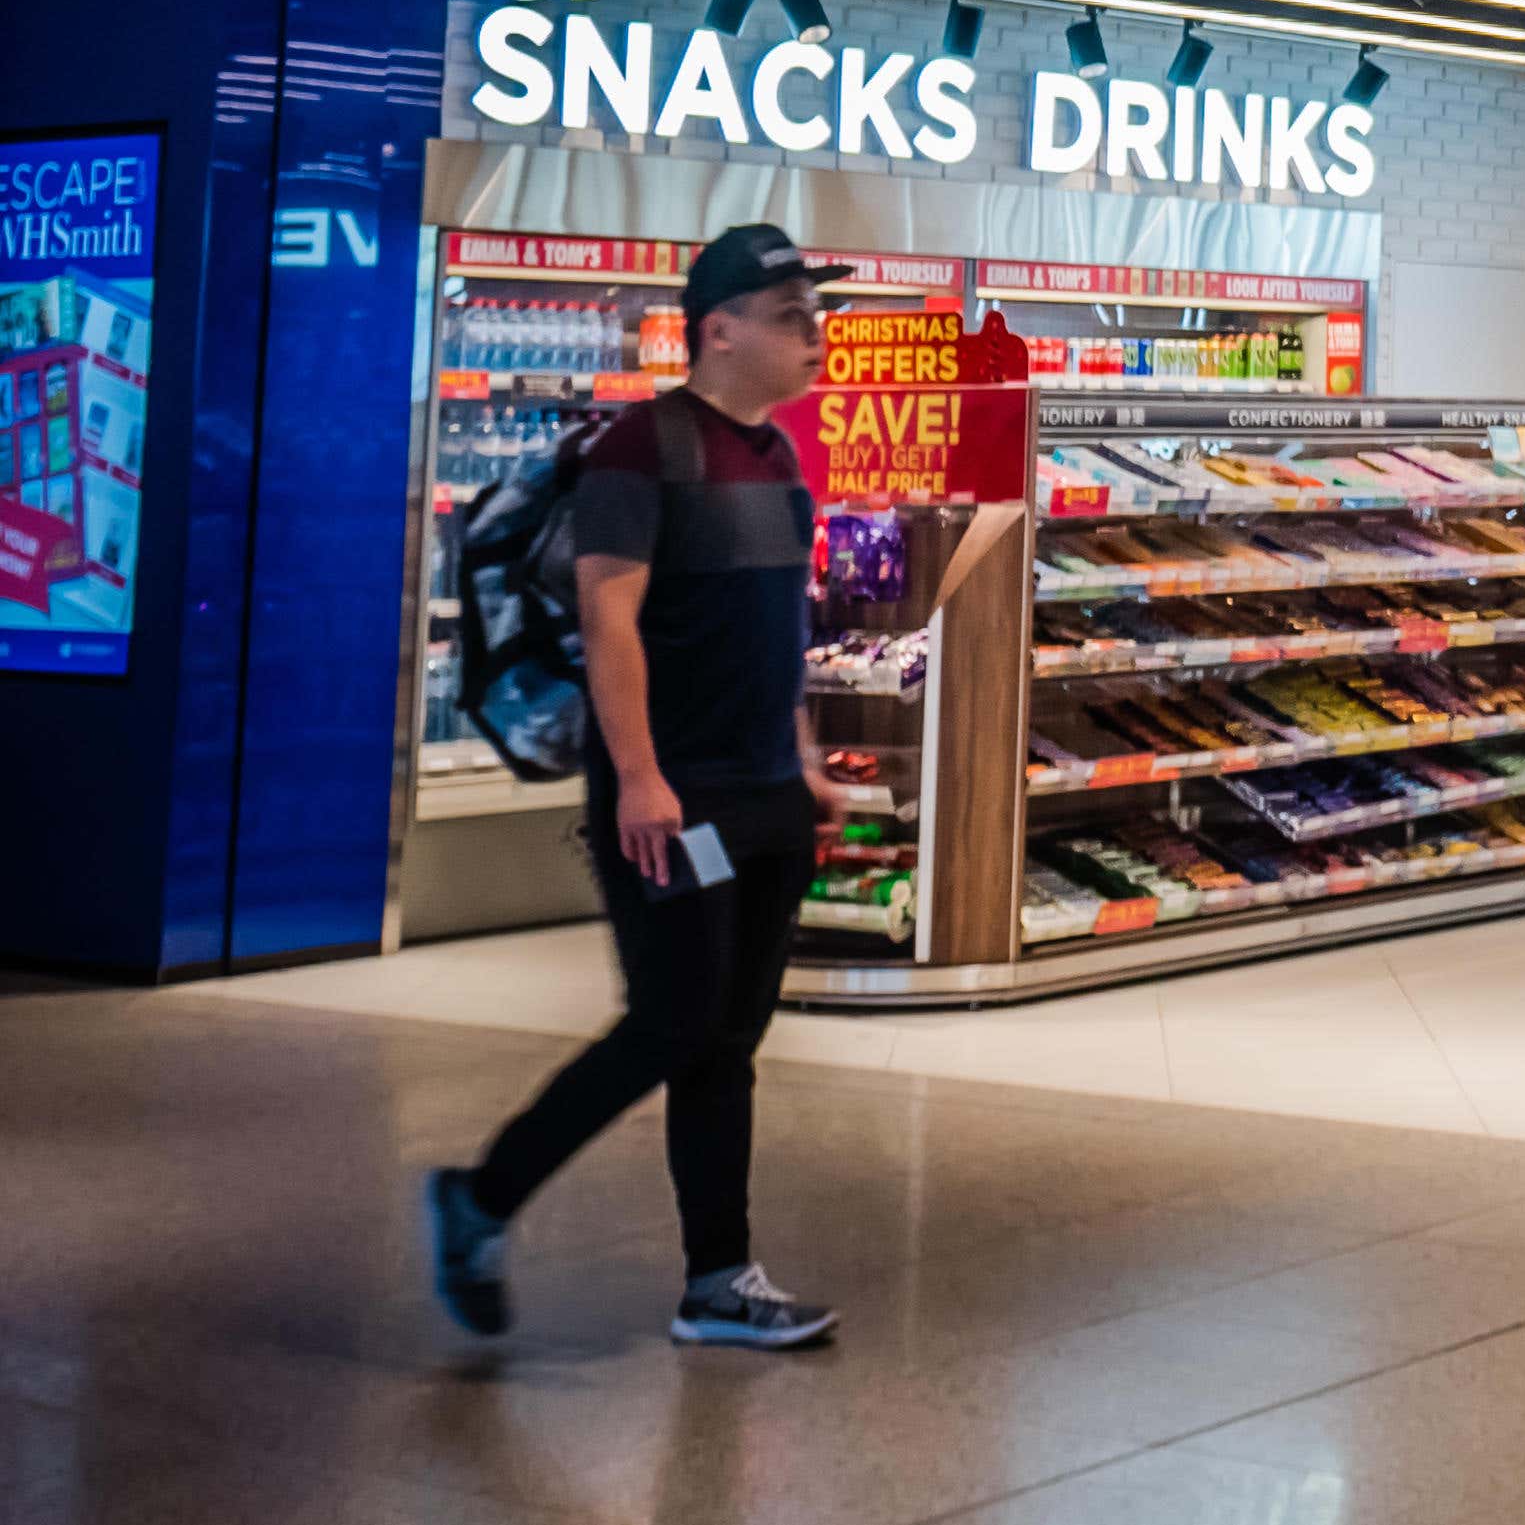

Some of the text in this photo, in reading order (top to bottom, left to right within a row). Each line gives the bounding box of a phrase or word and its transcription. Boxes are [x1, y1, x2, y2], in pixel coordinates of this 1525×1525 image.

[472, 6, 977, 163] SNACKS
[1030, 71, 1375, 197] DRINKS
[523, 240, 539, 266] &
[826, 315, 959, 344] CHRISTMAS
[827, 346, 960, 383] OFFERS
[818, 392, 962, 446] SAVE!
[1040, 407, 1105, 426] IONERY
[1228, 409, 1351, 427] CONFECTIONERY
[829, 444, 871, 469] BUY
[892, 446, 934, 469] GET
[828, 470, 946, 495] HALF PRICE
